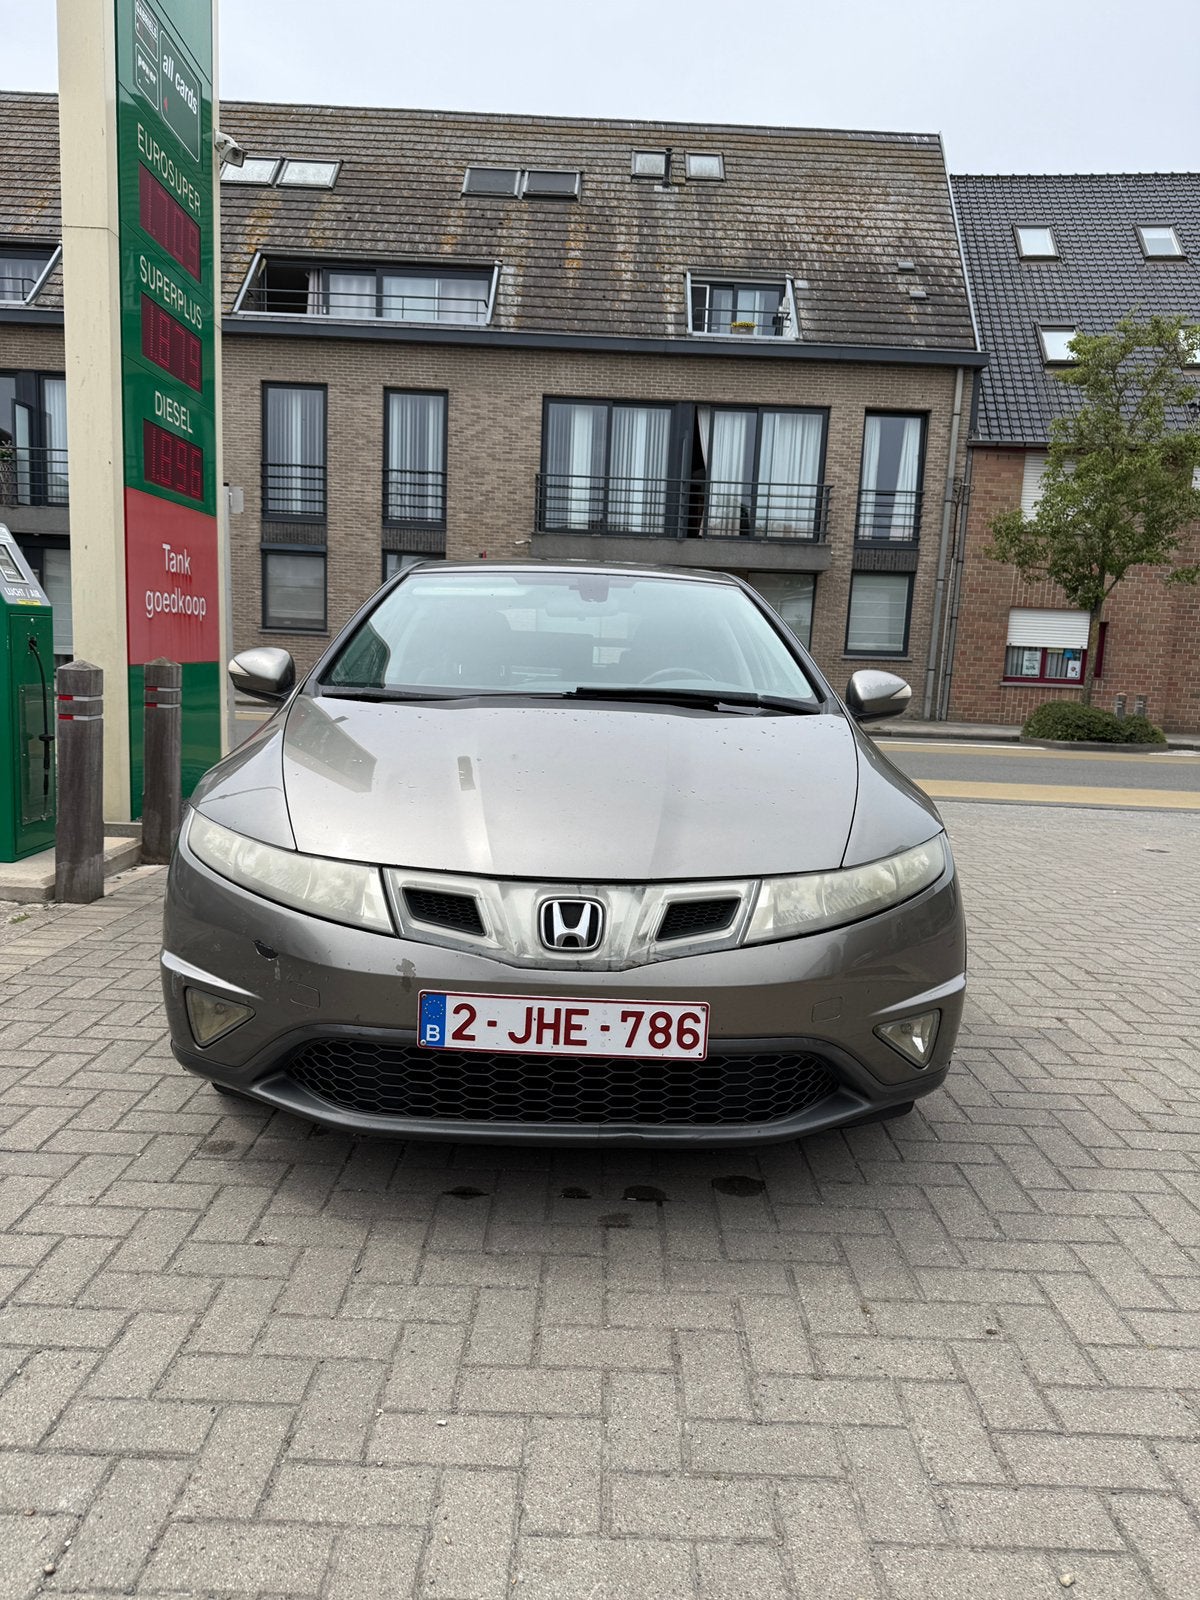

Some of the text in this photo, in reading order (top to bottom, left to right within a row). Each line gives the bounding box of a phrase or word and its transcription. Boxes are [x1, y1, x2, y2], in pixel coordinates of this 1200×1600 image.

[162, 54, 198, 115] all cards
[137, 122, 200, 217] EUROSUPER
[139, 255, 203, 329] SUPERPLUS
[154, 390, 194, 434] DIESEL
[162, 543, 191, 575] Tank
[145, 587, 207, 621] goedkoop
[426, 1002, 702, 1051] B 2-JHE-786
